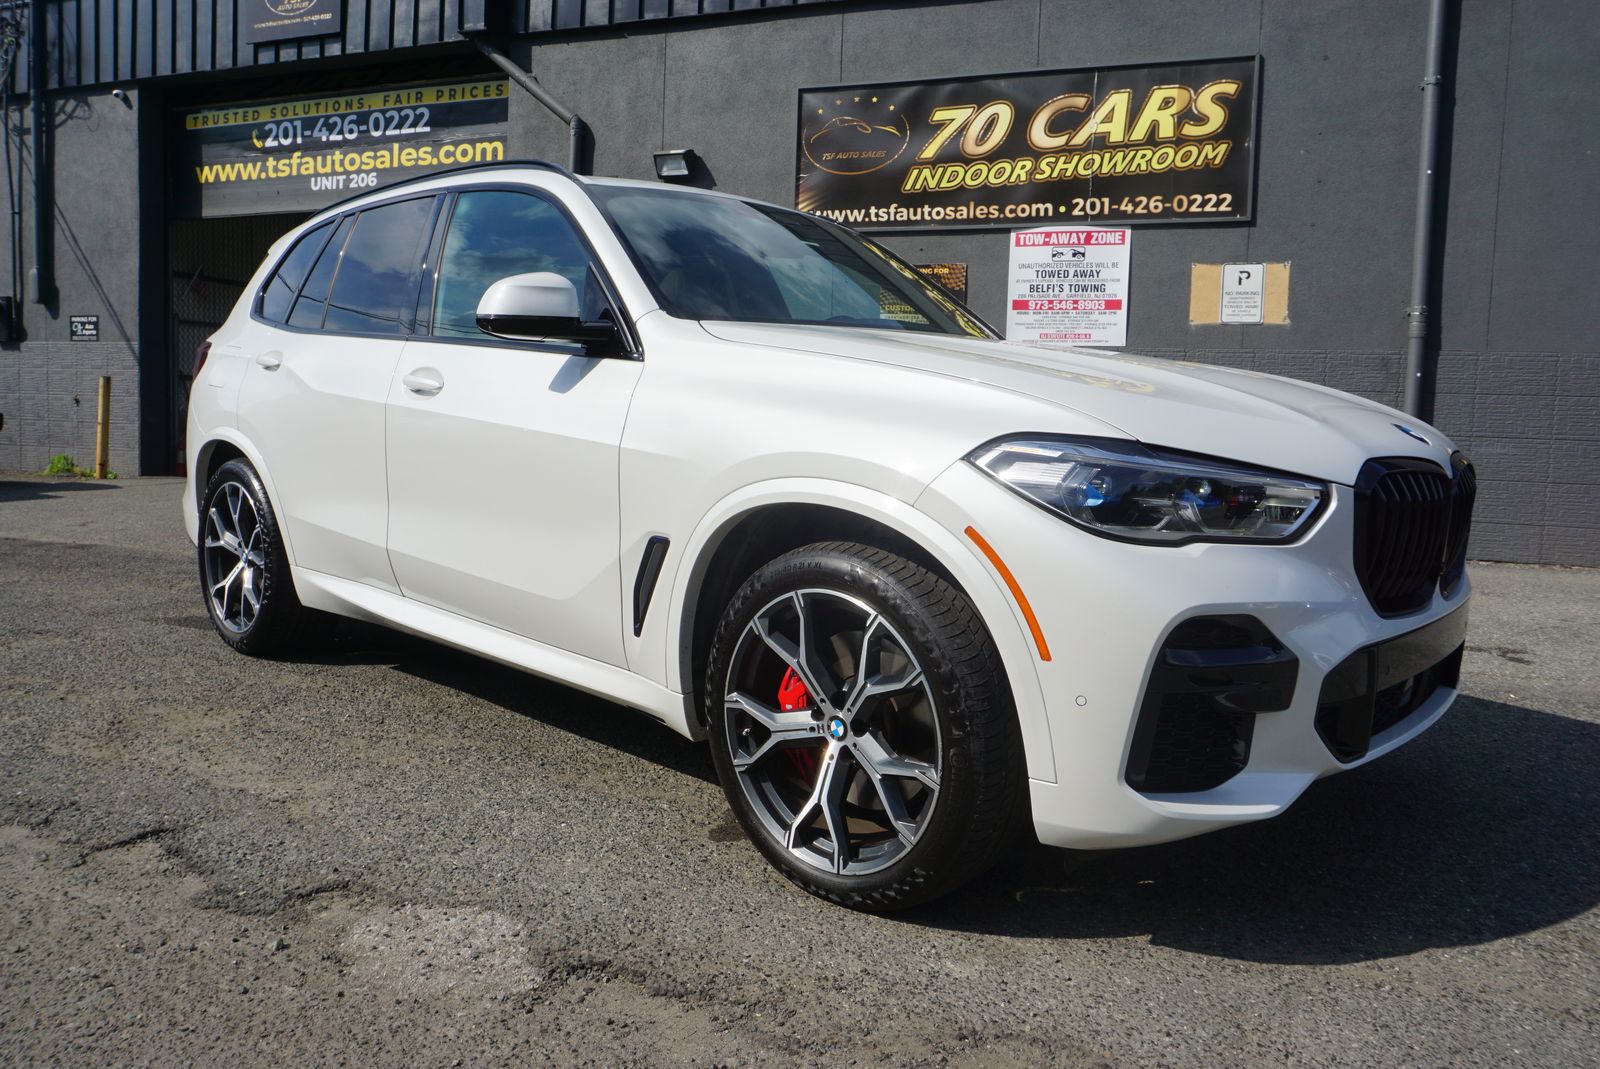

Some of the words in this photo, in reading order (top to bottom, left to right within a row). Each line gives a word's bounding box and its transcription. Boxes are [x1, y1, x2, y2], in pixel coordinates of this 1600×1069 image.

[192, 110, 260, 127] TRUSTED
[270, 97, 372, 119] SOLUTIONS,
[383, 91, 424, 107] FAIR
[436, 84, 504, 101] PRICES
[264, 106, 431, 147] 201-426-0222
[916, 99, 1015, 162] 70
[1027, 79, 1242, 150] CARS
[195, 140, 504, 184] www.tsfautosales.com
[822, 152, 836, 161] TSF
[836, 152, 860, 160] AUTO
[861, 150, 887, 159] SALES
[901, 158, 1034, 193] INDOOR
[1034, 141, 1232, 181] SHOWROOM
[310, 175, 346, 191] UNIT
[349, 172, 378, 189] 206
[1071, 193, 1233, 217] 201-426-0222
[1018, 232, 1087, 245] TOW-AWAY
[1091, 231, 1123, 244] ZONE
[1035, 269, 1069, 279] TOWED
[1072, 269, 1102, 278] AWAY
[1029, 283, 1064, 293] BELFI'S
[1068, 283, 1106, 293] TOWING
[1028, 300, 1105, 310] 973-546-8903
